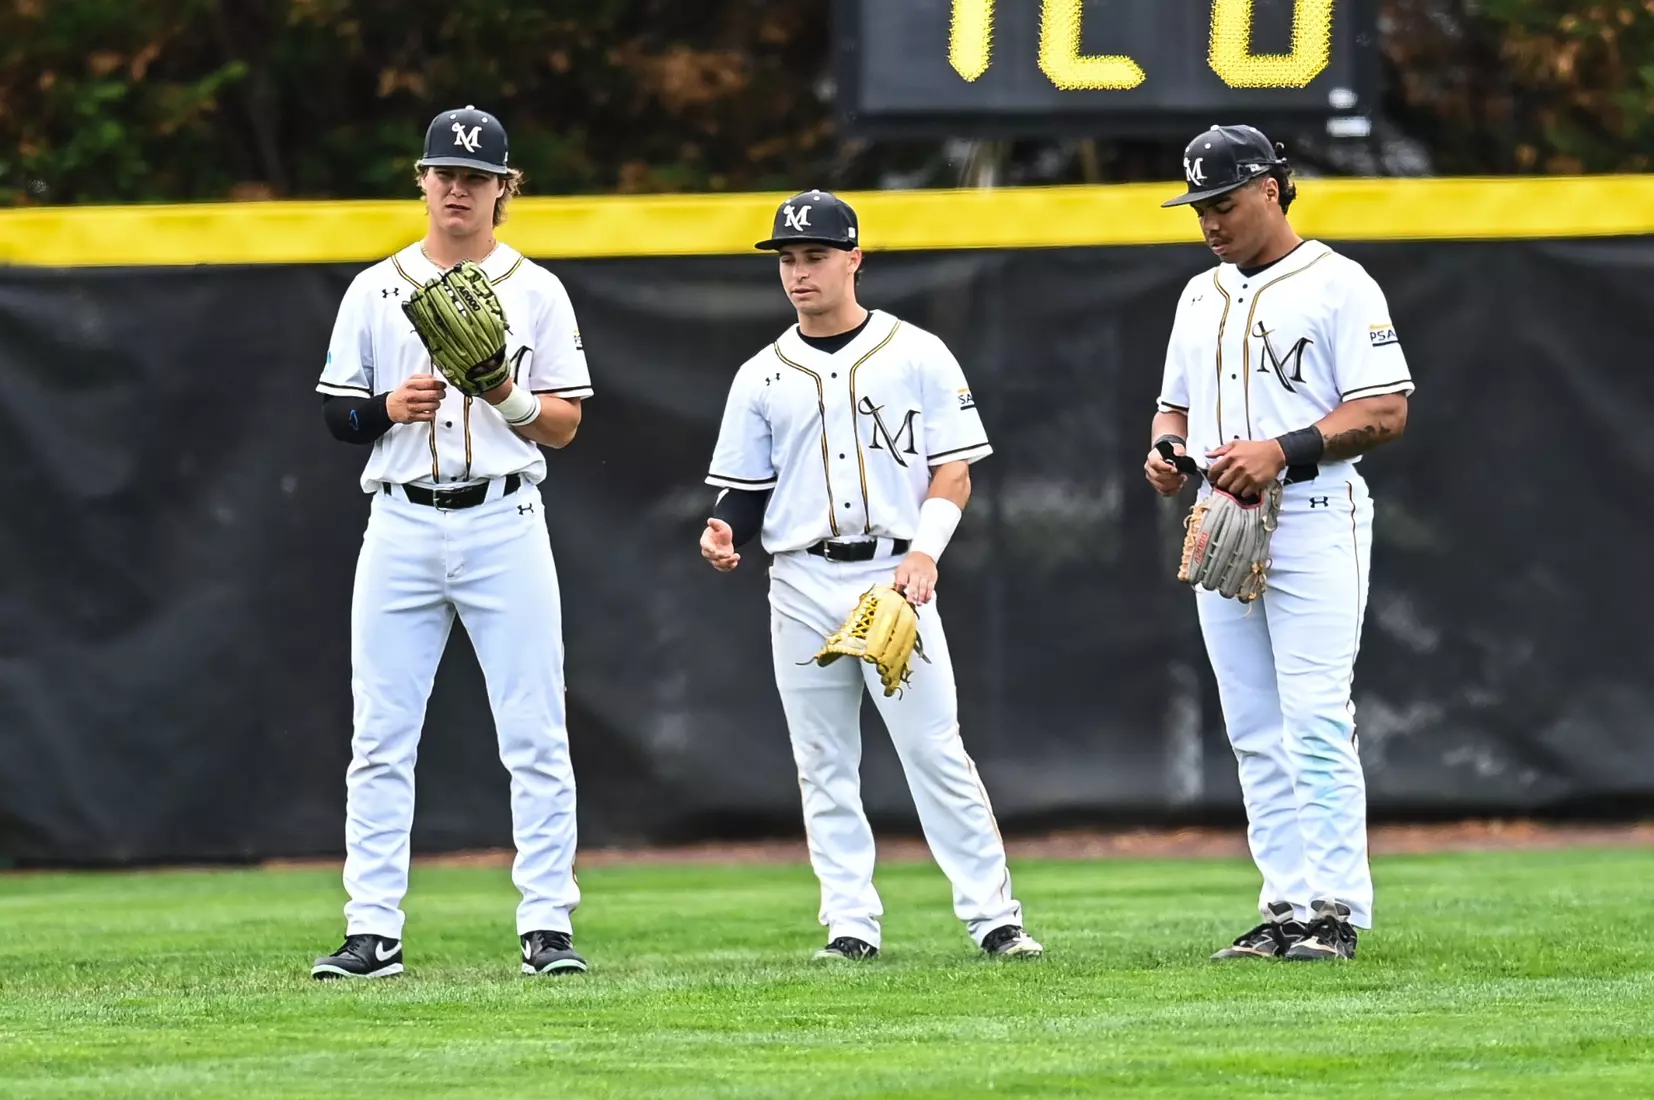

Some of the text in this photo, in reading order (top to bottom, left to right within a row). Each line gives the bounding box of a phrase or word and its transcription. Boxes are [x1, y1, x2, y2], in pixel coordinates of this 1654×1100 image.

[451, 121, 483, 153] M
[1183, 157, 1208, 187] M
[783, 204, 812, 232] M
[1251, 320, 1314, 393] M
[857, 395, 922, 468] M
